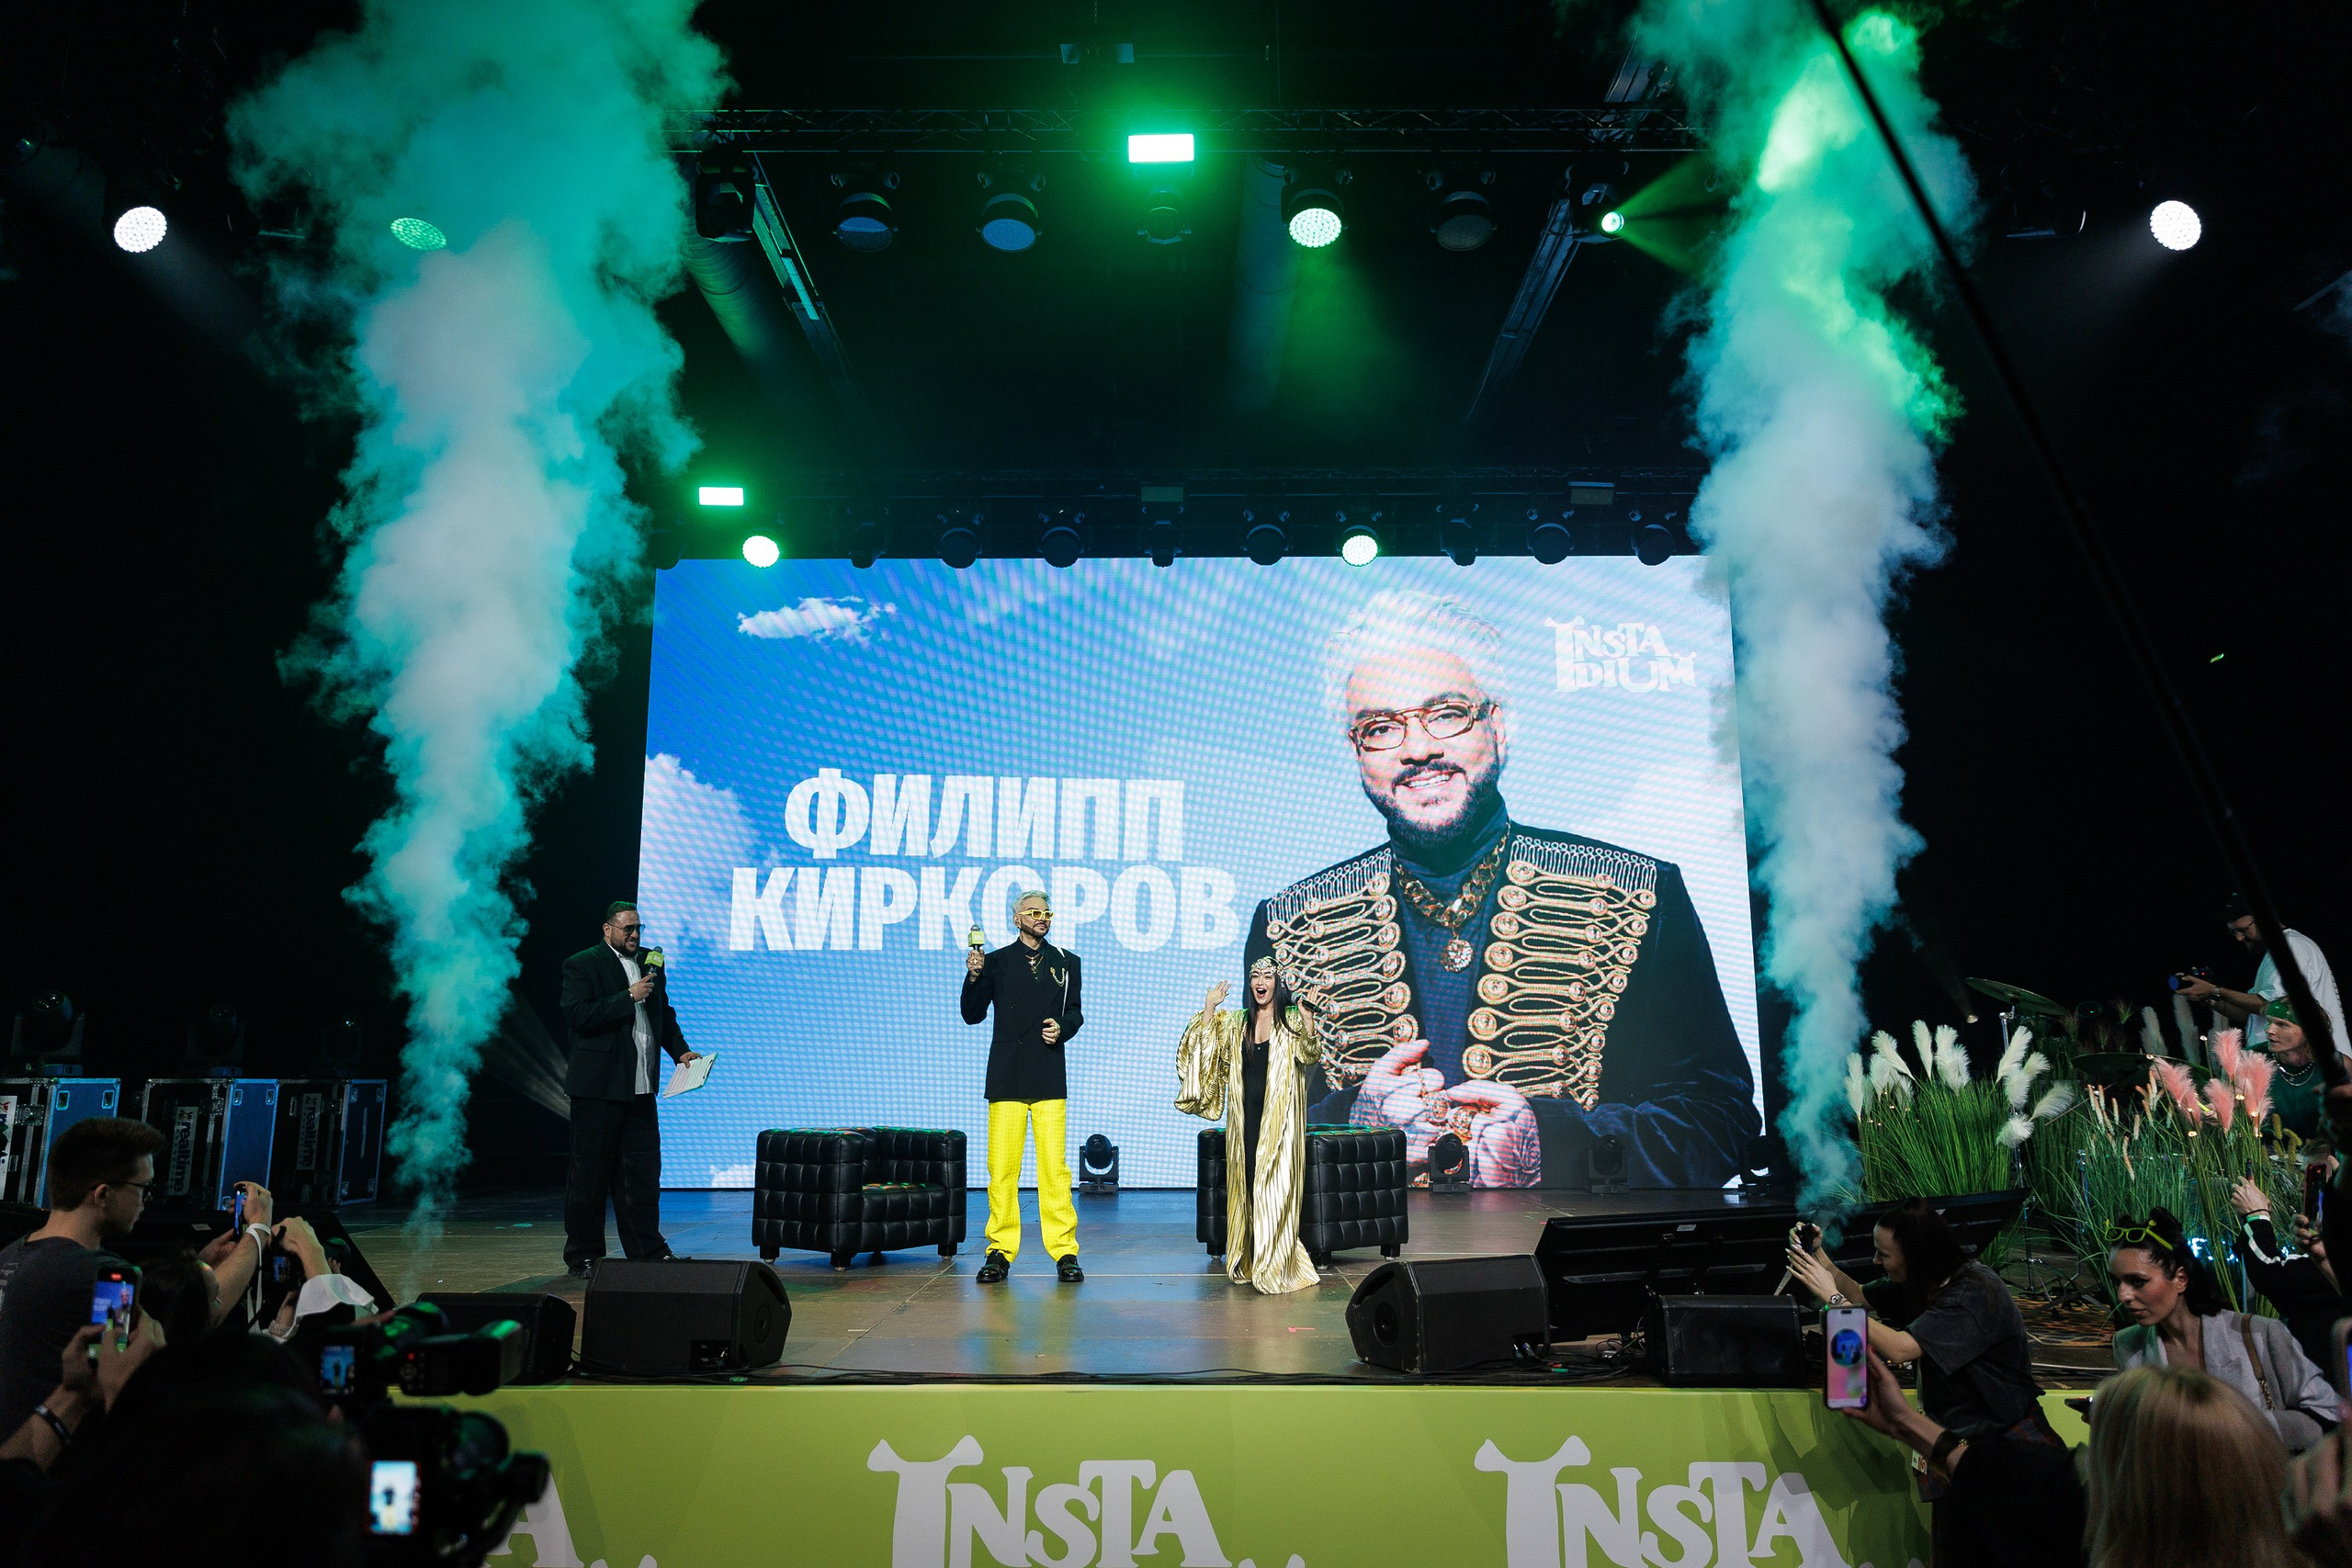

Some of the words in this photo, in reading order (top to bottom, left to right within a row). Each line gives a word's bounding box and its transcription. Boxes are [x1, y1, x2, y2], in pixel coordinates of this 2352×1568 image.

[1574, 651, 1698, 693] DIUM
[784, 768, 1185, 861] ФИЛИПП
[729, 865, 1238, 952] КИРКОРОВ
[174, 1122, 191, 1192] realtime
[867, 1435, 1232, 1568] INSTA
[1474, 1435, 1851, 1568] INSTA
